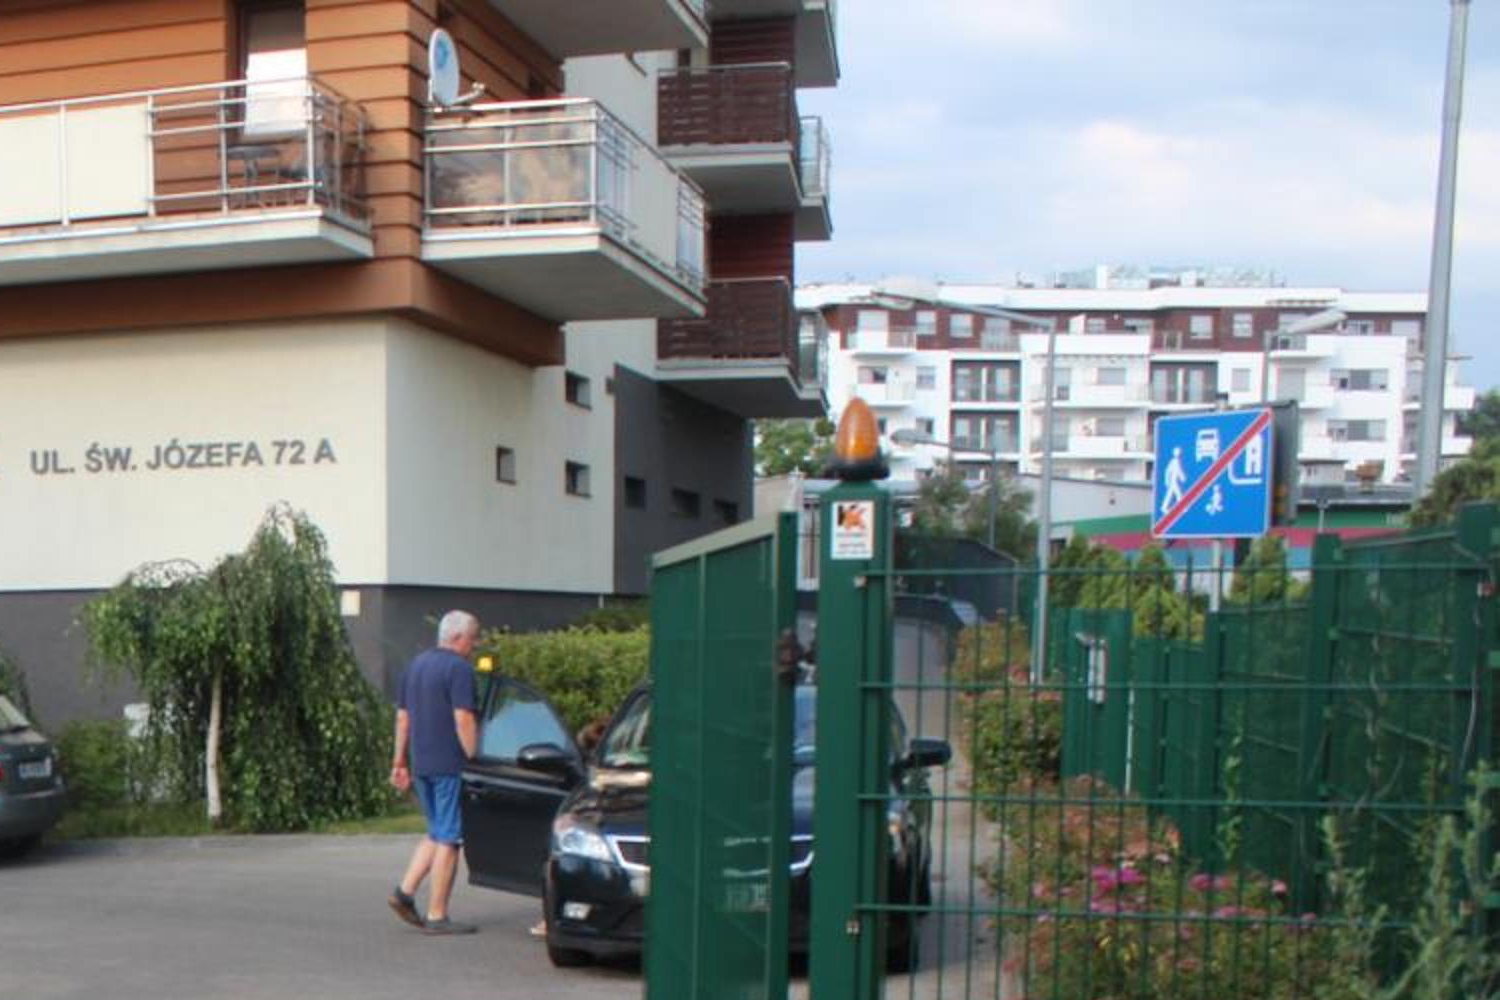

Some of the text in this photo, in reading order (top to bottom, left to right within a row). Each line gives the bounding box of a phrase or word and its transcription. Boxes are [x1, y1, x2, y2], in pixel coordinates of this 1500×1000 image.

[30, 438, 337, 474] UL. ŚW. JÓZEFA 72 A
